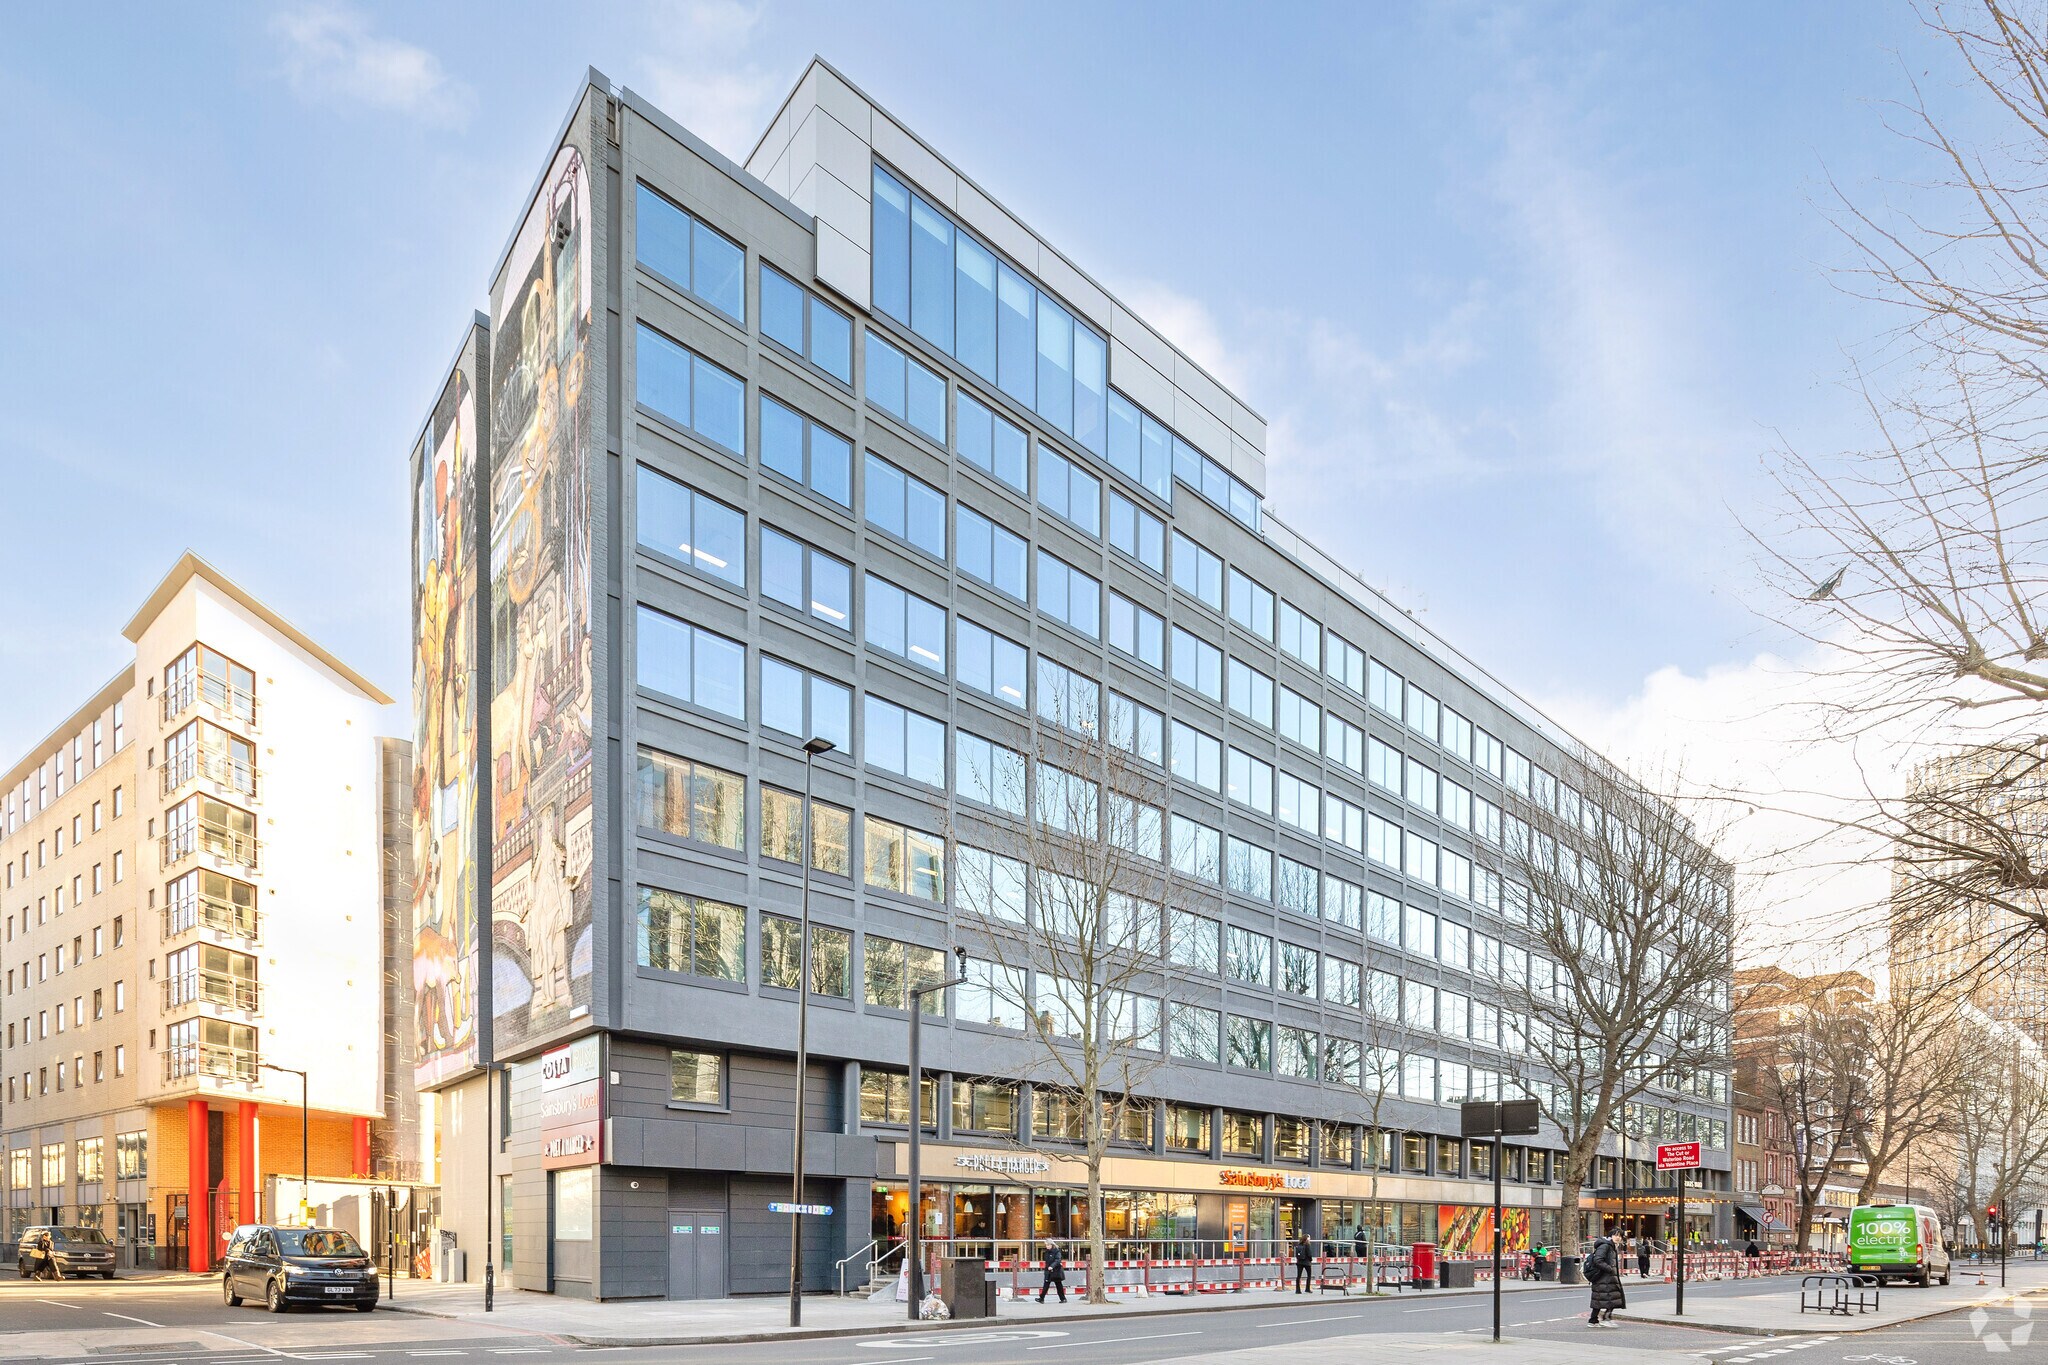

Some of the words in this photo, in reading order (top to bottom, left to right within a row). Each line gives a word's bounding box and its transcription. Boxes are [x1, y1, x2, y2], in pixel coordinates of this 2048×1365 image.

[540, 1095, 577, 1119] Sainsbury's
[577, 1089, 598, 1110] Local
[1220, 1170, 1284, 1191] Sainsbury's
[1284, 1173, 1311, 1189] Local
[1856, 1221, 1911, 1235] 100%
[1857, 1234, 1911, 1245] electric
